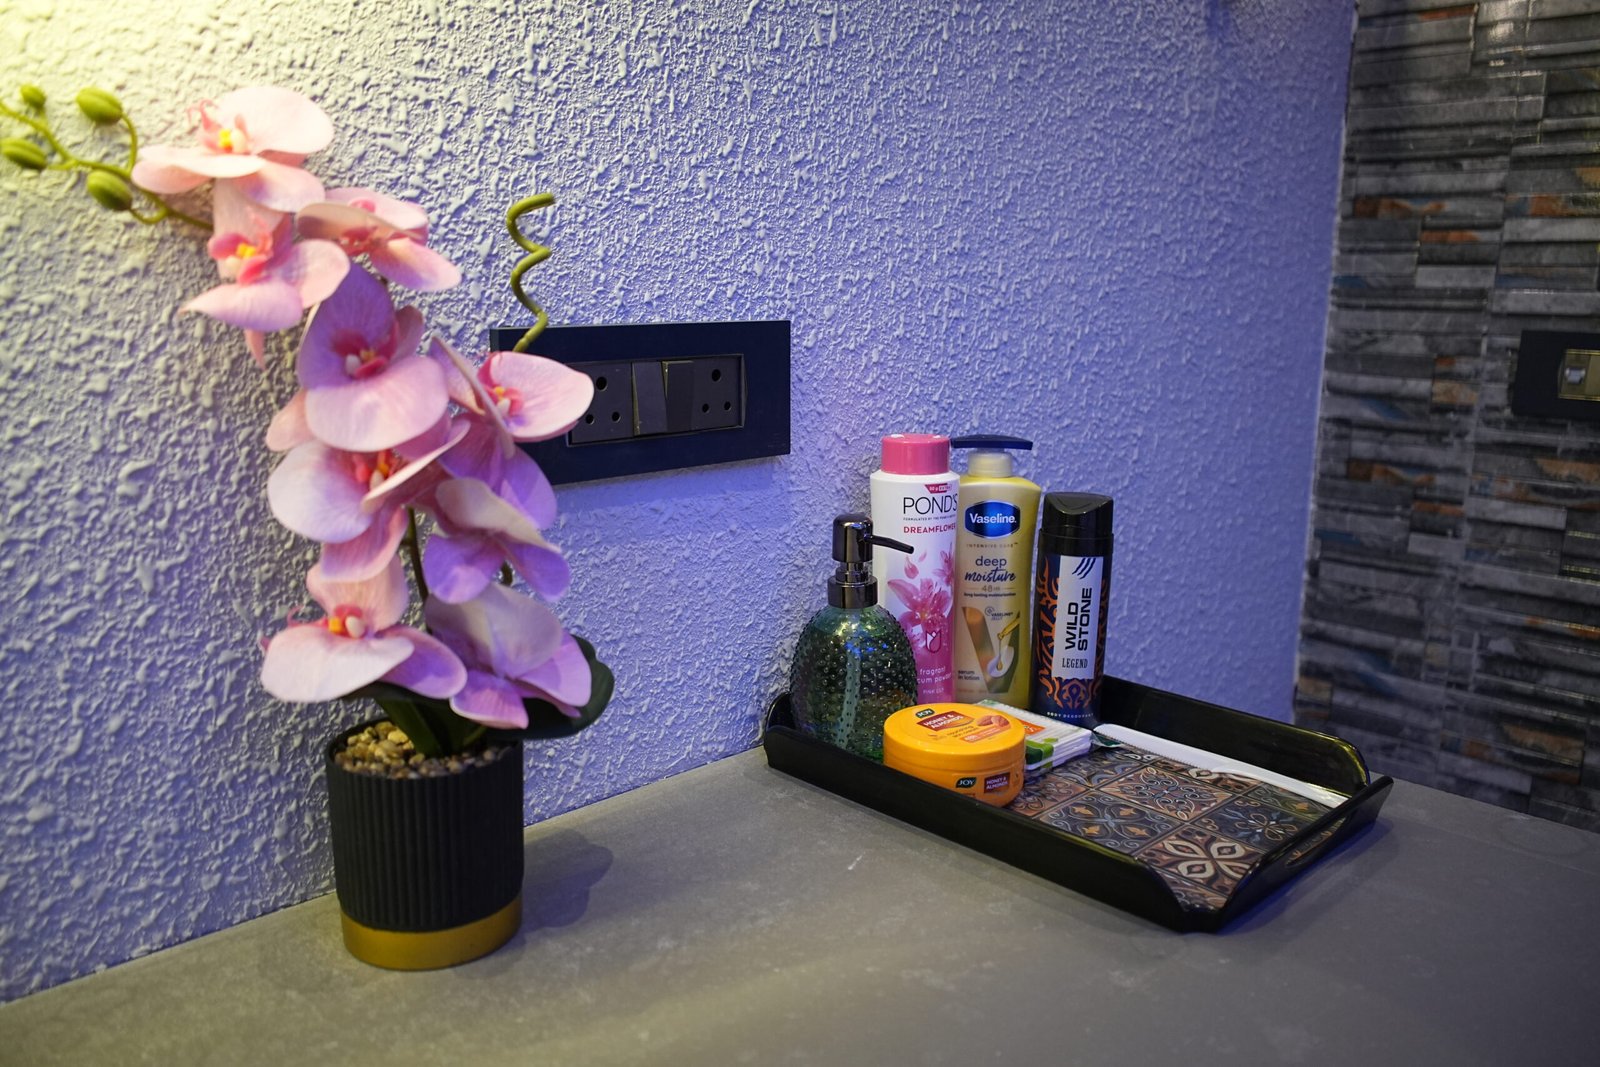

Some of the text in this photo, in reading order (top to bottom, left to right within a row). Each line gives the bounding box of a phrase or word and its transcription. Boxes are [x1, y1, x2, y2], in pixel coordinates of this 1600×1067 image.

[975, 555, 1007, 569] deep
[964, 566, 1017, 583] moisture
[1064, 602, 1079, 651] WILD
[1077, 587, 1093, 652] STONE
[1061, 657, 1089, 669] LEGEND
